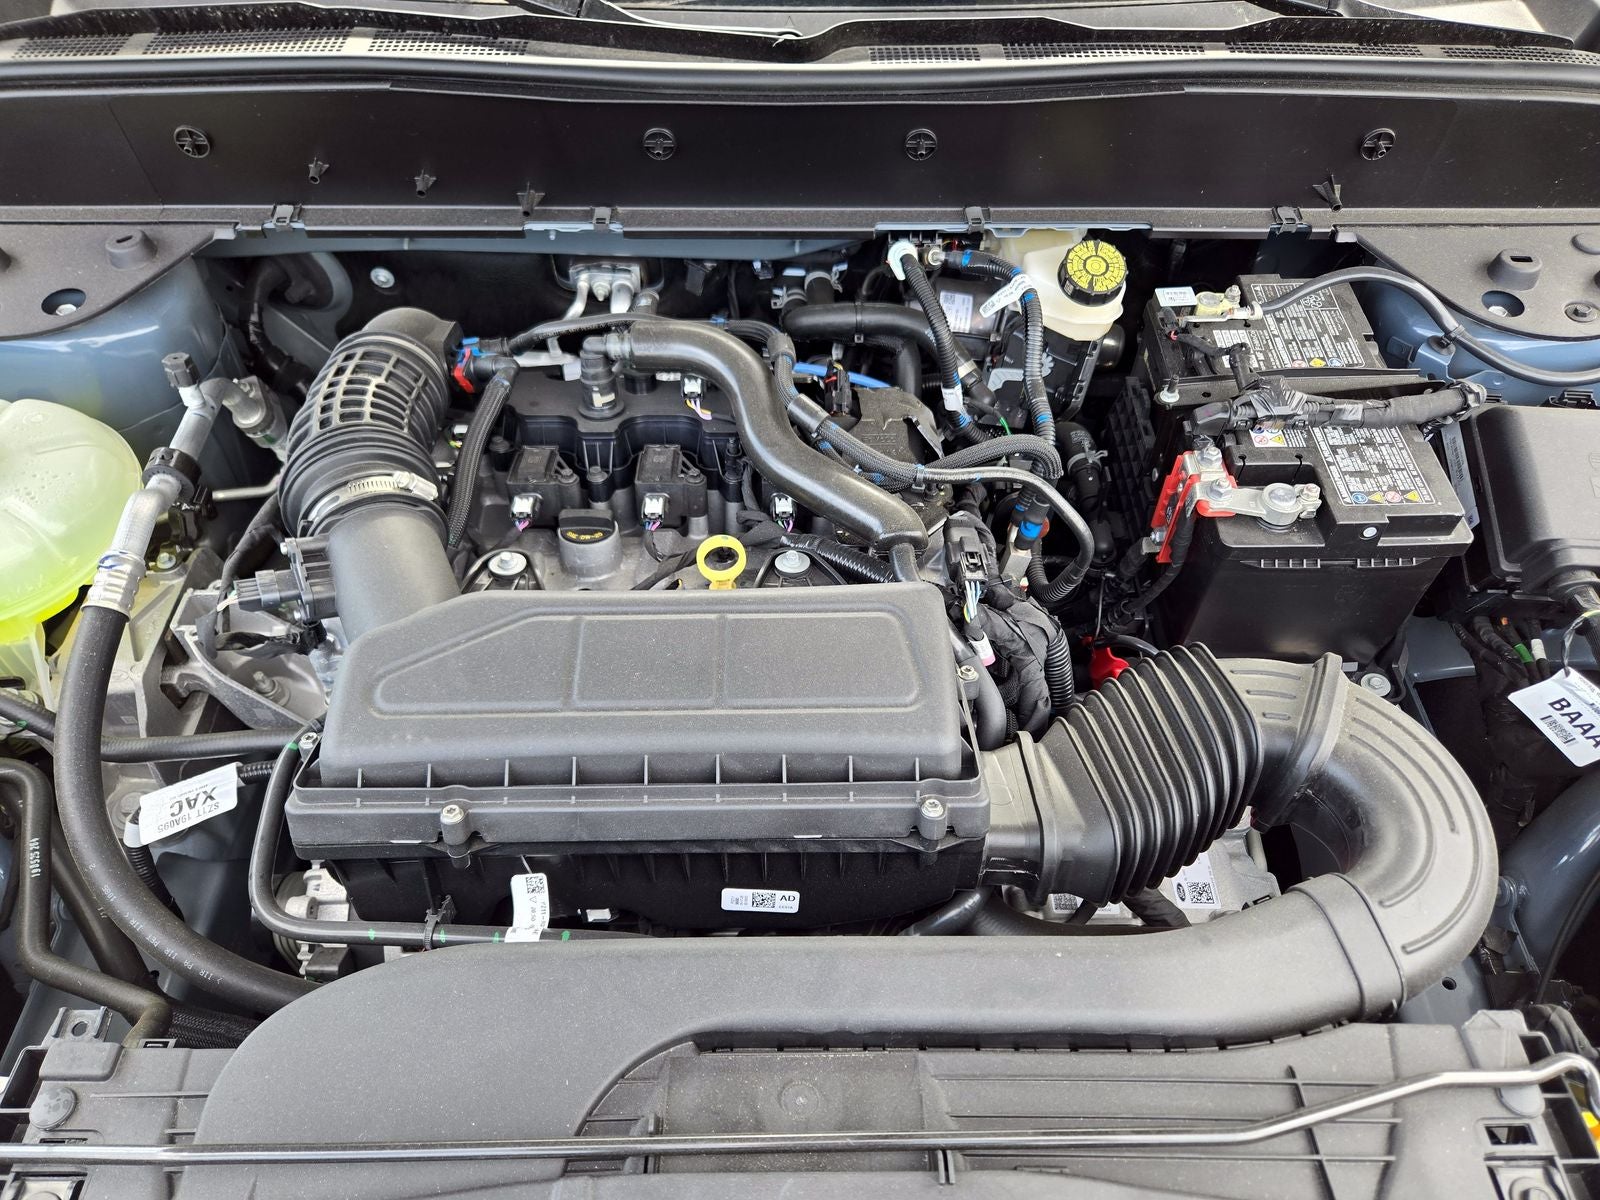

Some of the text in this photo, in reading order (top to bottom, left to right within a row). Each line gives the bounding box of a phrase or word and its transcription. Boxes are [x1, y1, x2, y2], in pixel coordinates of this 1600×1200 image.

[1548, 697, 1600, 749] BAAA
[169, 786, 218, 818] XAC
[780, 894, 796, 902] AD
